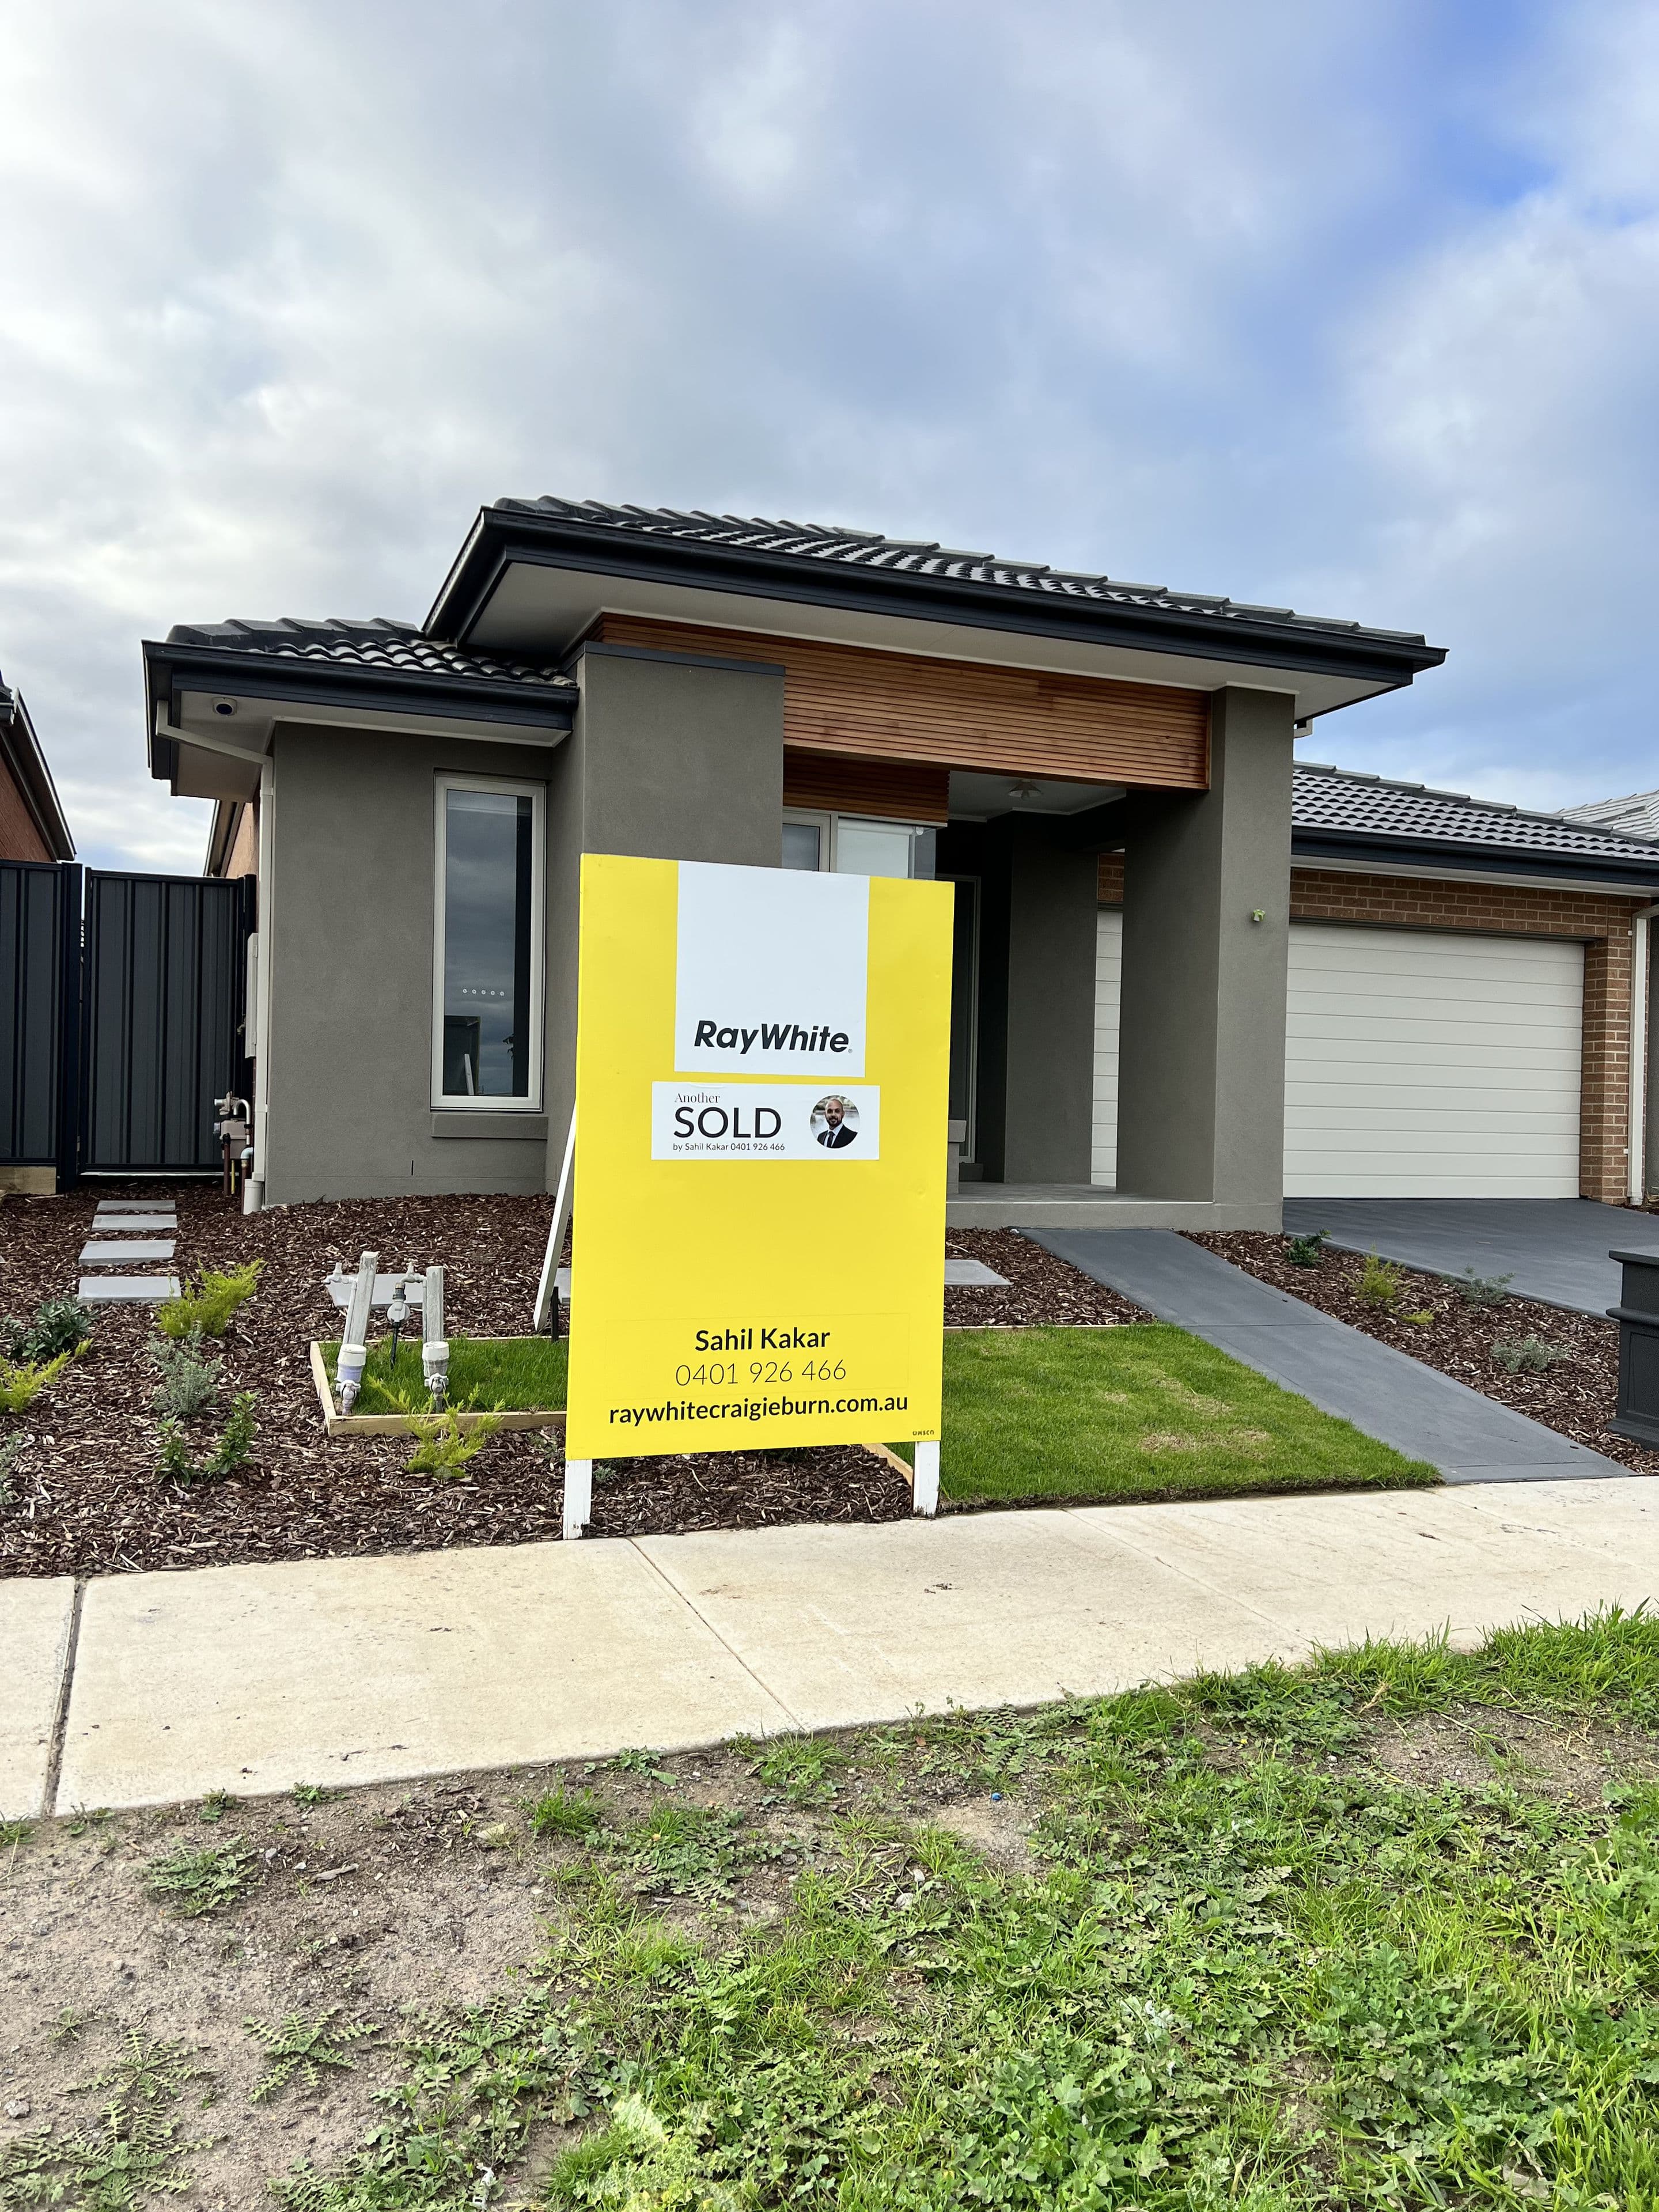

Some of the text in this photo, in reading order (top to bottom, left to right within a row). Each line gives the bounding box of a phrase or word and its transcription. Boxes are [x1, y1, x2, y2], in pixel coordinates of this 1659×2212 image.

[675, 1092, 721, 1104] Another
[673, 1106, 782, 1138] SOLD
[673, 1142, 785, 1152] by Sahil Kakar 0401 926 466
[695, 1327, 831, 1351] Sahil Kakar
[676, 1359, 847, 1387] 0401 926 466
[609, 1396, 908, 1427] raywhitecraigieburn.com.au
